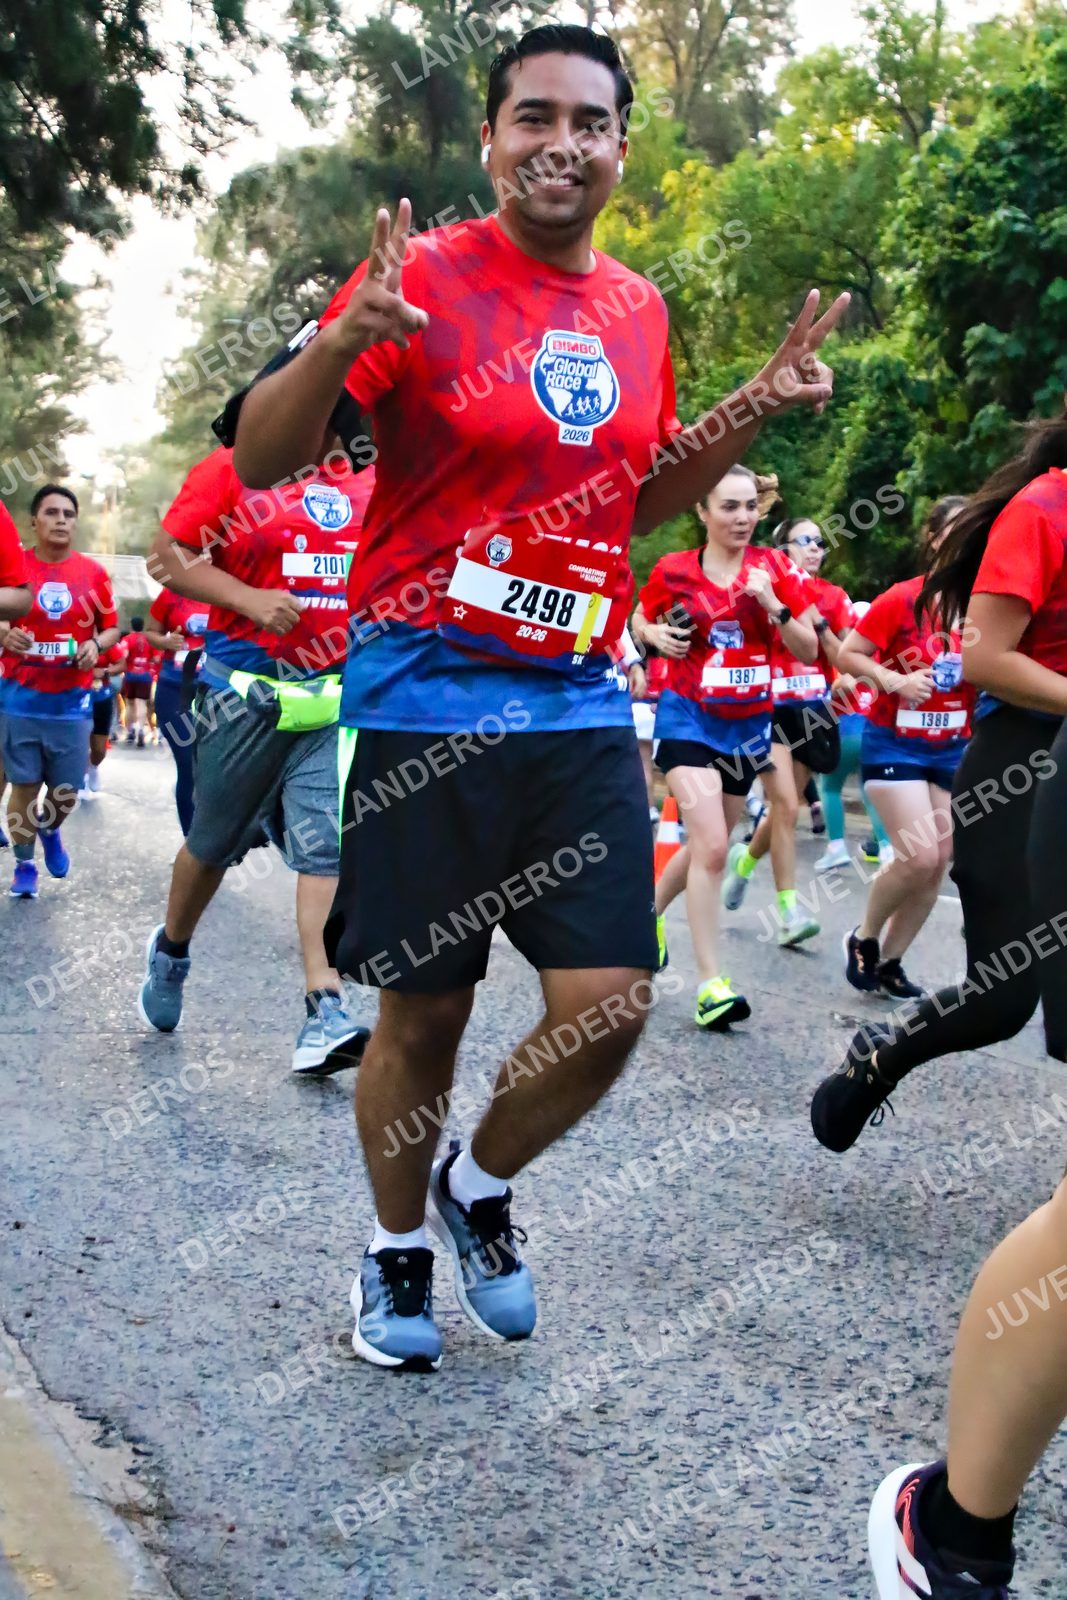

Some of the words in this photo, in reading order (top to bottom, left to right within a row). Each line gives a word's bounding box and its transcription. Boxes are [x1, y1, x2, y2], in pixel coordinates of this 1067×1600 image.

[552, 339, 597, 356] BIMBO
[553, 357, 598, 379] Global
[545, 370, 582, 391] Race
[562, 428, 590, 442] 2026
[313, 555, 345, 575] 2101
[500, 578, 577, 628] 2498
[728, 668, 757, 684] 1387
[921, 712, 950, 727] 1388
